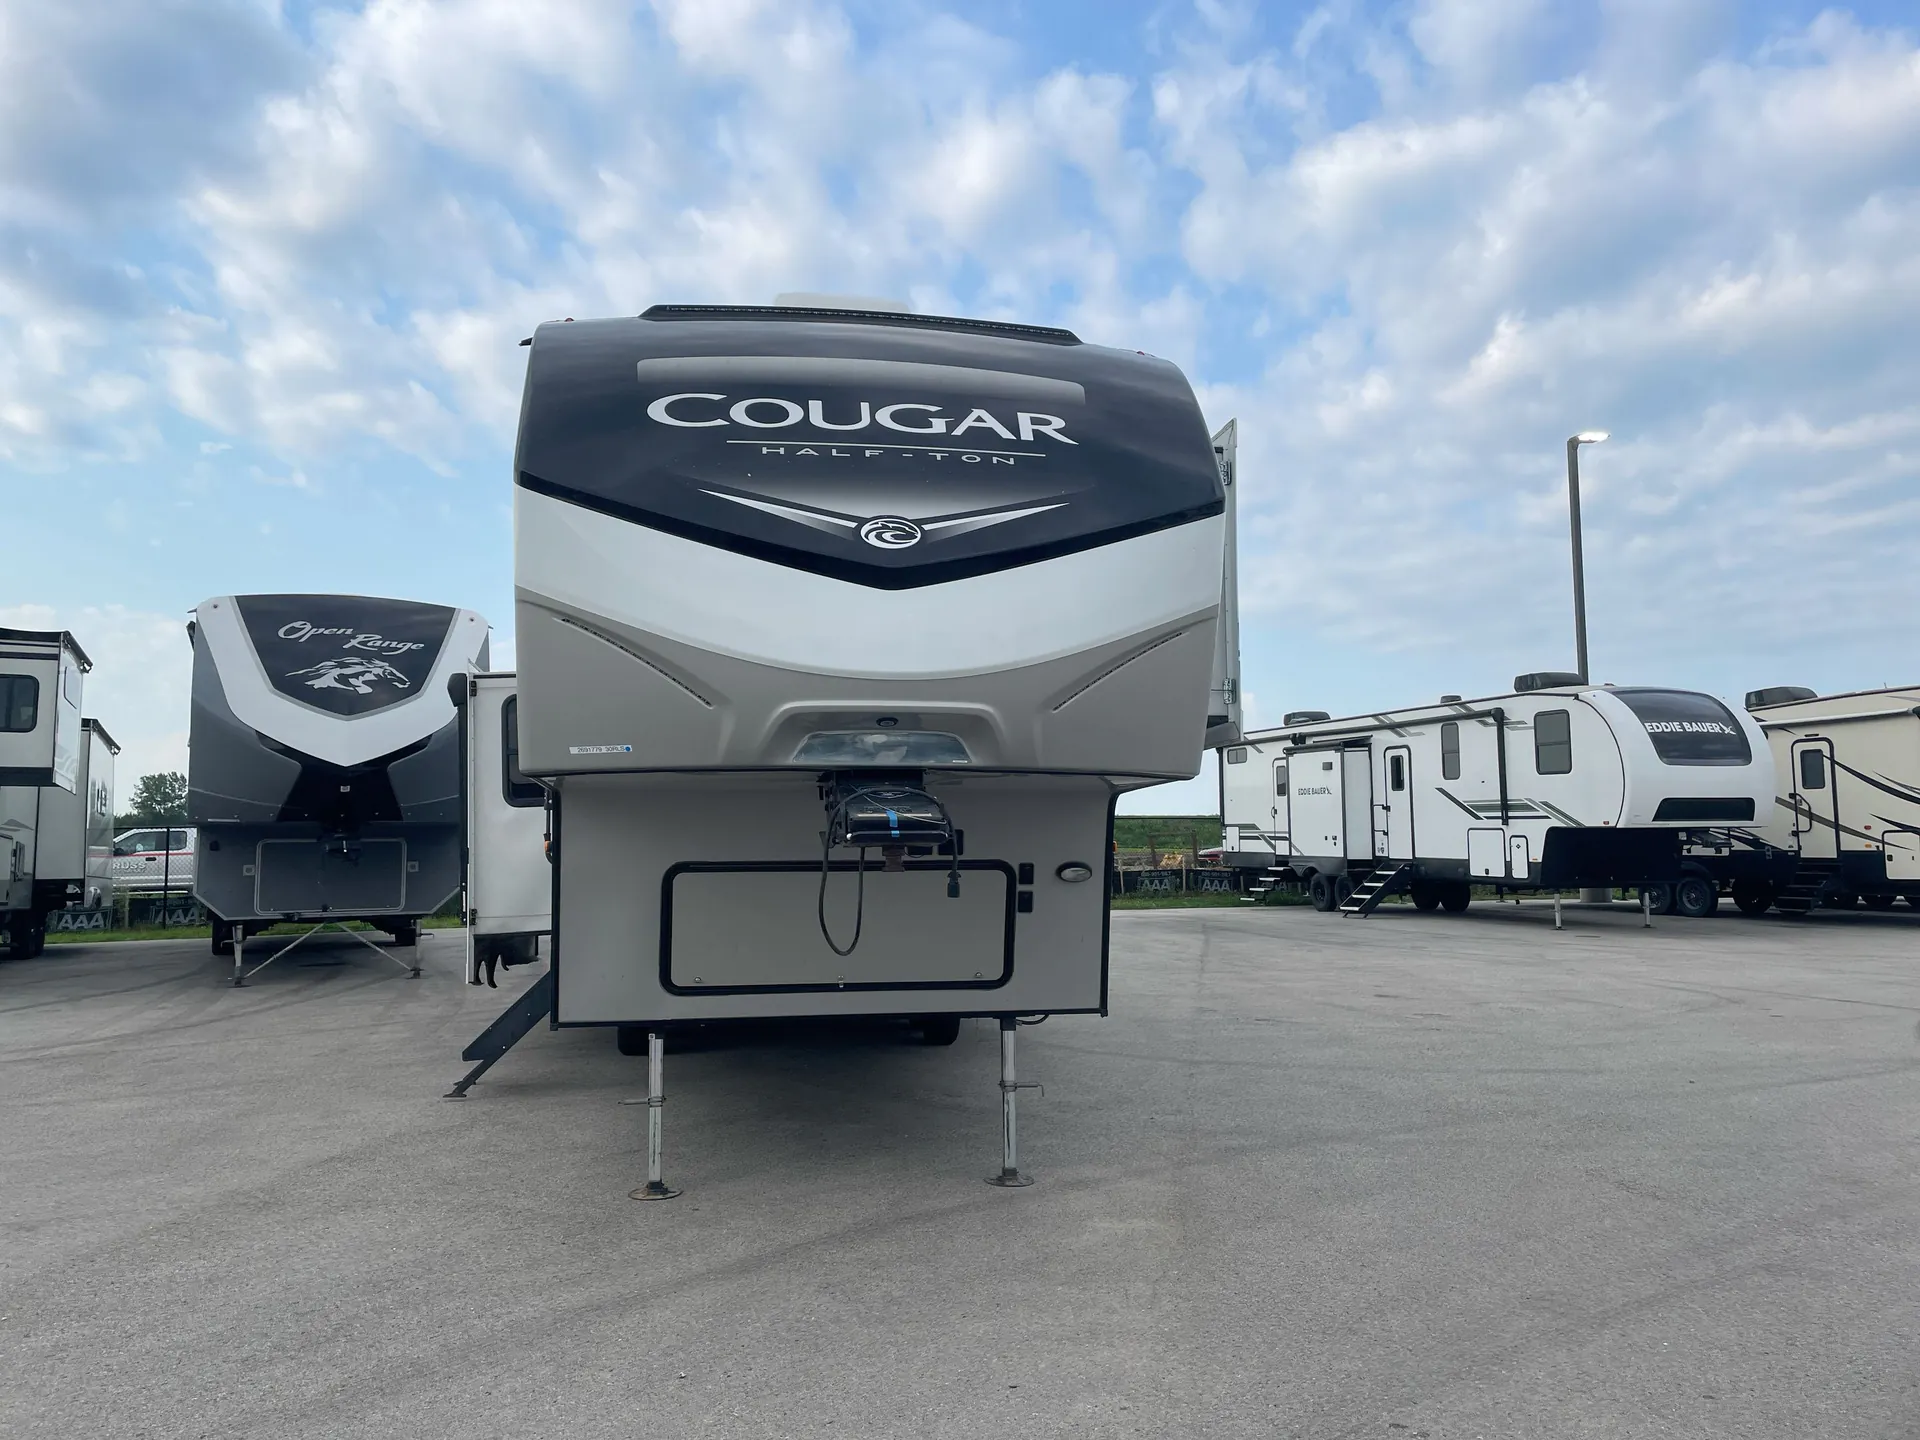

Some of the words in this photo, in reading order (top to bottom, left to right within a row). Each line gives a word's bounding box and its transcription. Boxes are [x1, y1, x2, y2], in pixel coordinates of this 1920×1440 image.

[647, 393, 1079, 445] COUGAR
[762, 447, 1015, 465] HALF-TON
[278, 621, 353, 642] Open
[342, 634, 425, 655] Range
[1644, 722, 1683, 733] EDDIE
[1682, 722, 1722, 733] BAUER
[1298, 787, 1311, 796] EDDIE
[1311, 786, 1327, 795] BAUER
[1202, 879, 1231, 892] AAA
[57, 913, 104, 930] AAA
